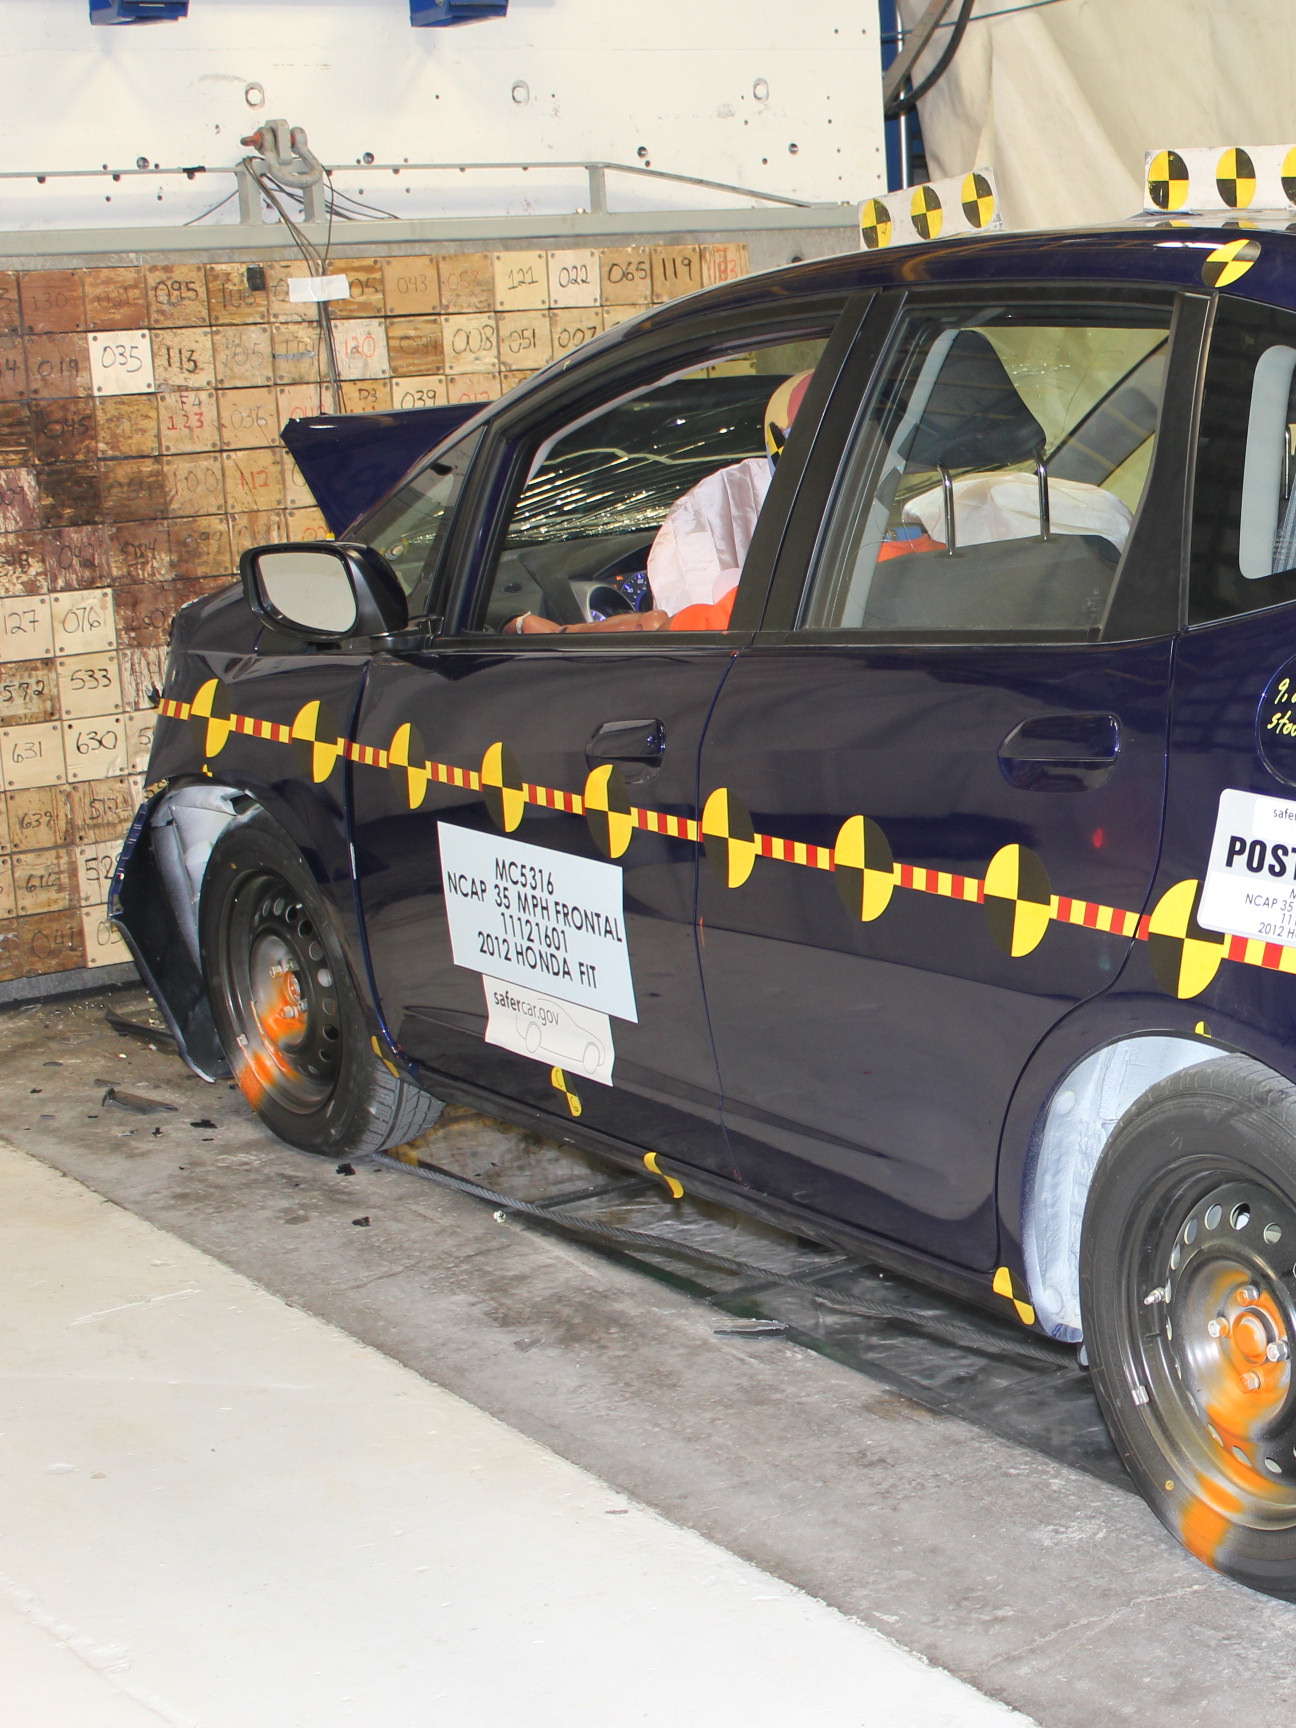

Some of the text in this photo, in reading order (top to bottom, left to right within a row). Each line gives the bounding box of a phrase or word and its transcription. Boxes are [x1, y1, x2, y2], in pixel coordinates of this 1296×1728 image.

[508, 266, 539, 290] 121
[559, 265, 590, 288] 022
[608, 261, 649, 284] 065
[662, 257, 692, 282] 119
[155, 280, 198, 305] 095
[397, 274, 428, 294] 043
[343, 334, 376, 359] 120
[452, 324, 495, 355] 008
[507, 329, 537, 354] 051
[101, 344, 142, 373] 035
[166, 346, 199, 373] 113
[358, 388, 378, 402] D3
[167, 412, 205, 431] 123
[4, 609, 40, 634] 127
[62, 606, 101, 633] 076
[71, 668, 112, 690] 533
[12, 741, 43, 763] 631
[76, 731, 118, 754] 630
[495, 857, 555, 895] MC5316
[447, 871, 623, 943] NCAP 35 MPH FRONTAL
[1245, 893, 1278, 909] NCAP
[1280, 901, 1294, 913] 35
[501, 912, 568, 953] 11121601
[1258, 922, 1285, 937] 2012
[477, 931, 597, 989] 2012 HONDA FIT
[493, 990, 560, 1026] safercar.gov
